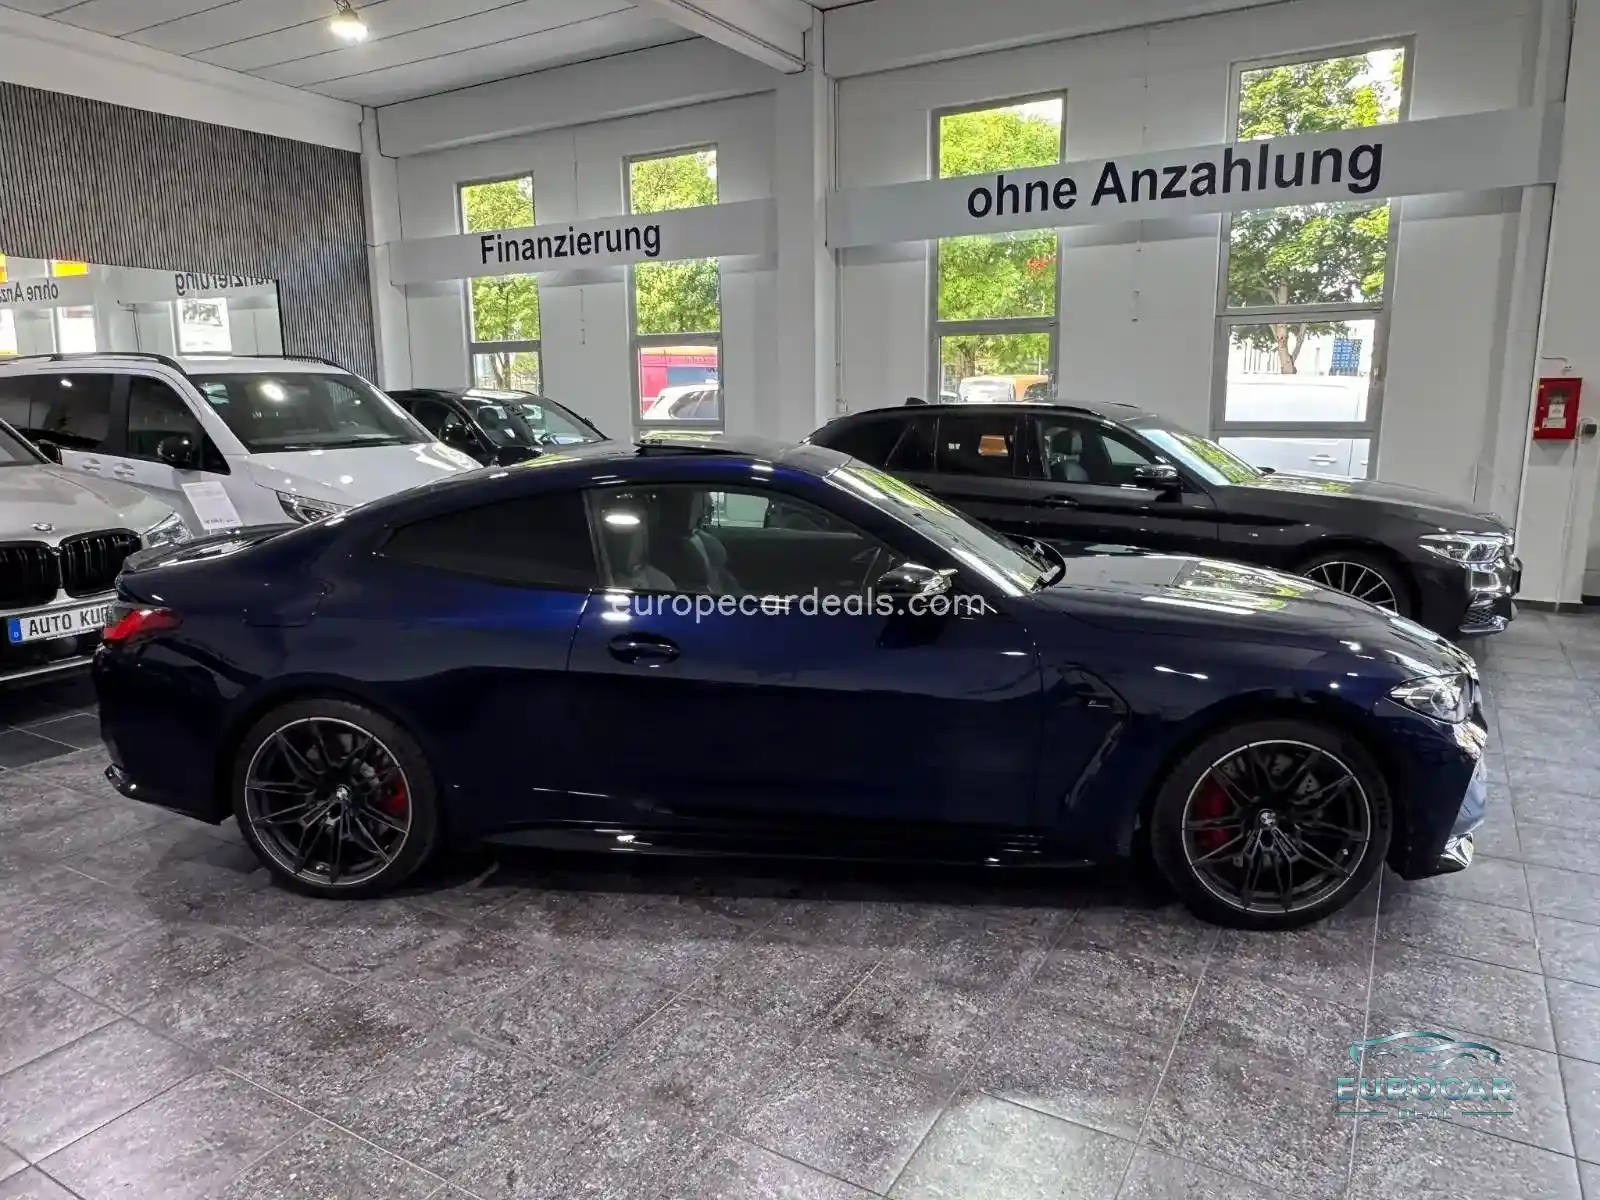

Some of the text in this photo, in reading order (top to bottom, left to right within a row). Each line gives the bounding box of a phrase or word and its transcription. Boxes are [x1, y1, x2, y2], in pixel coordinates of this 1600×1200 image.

[967, 143, 1383, 219] ohne Anzahlung
[480, 224, 661, 265] Finanzierung
[29, 613, 72, 637] AUTO
